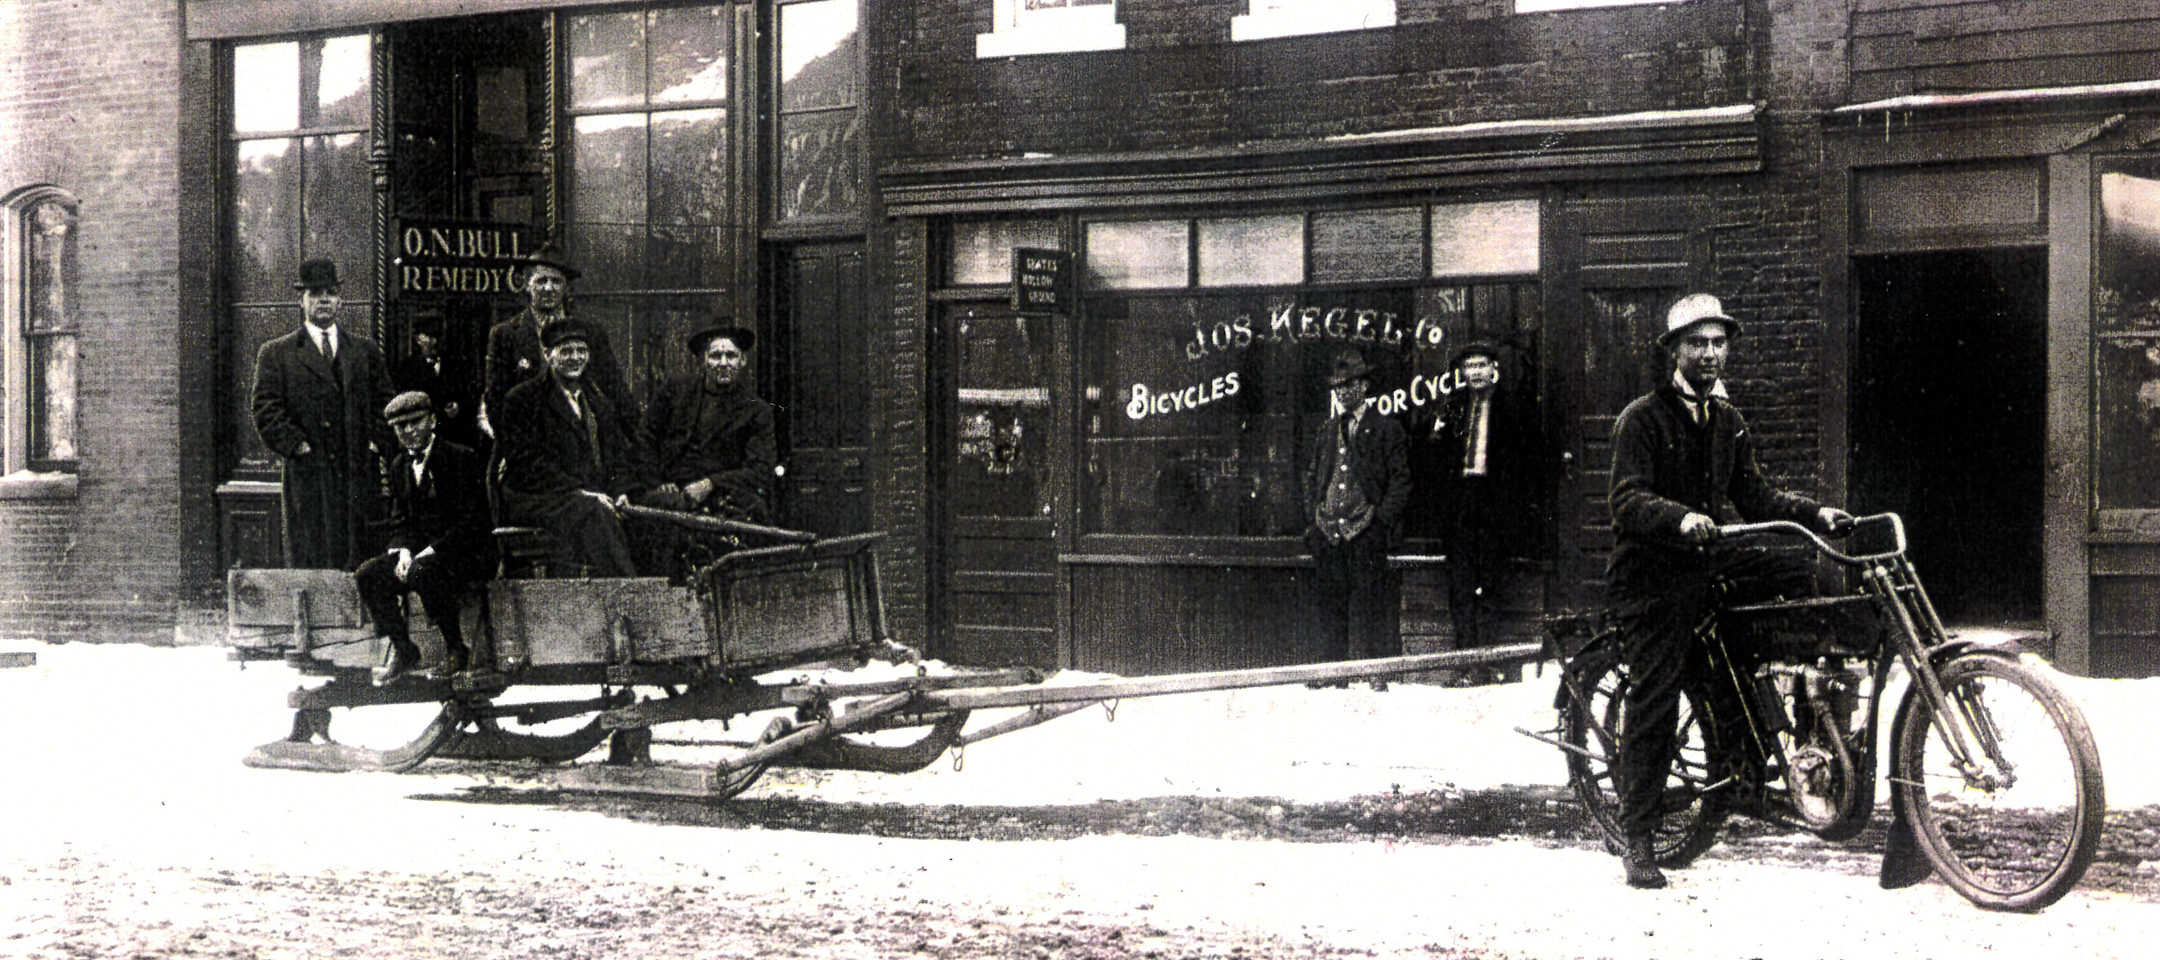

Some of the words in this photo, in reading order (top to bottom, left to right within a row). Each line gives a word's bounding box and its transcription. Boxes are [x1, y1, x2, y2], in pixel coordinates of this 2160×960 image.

[403, 265, 504, 292] REMEDY
[1266, 302, 1402, 344] KEGEL
[1126, 371, 1240, 420] BICYCLES
